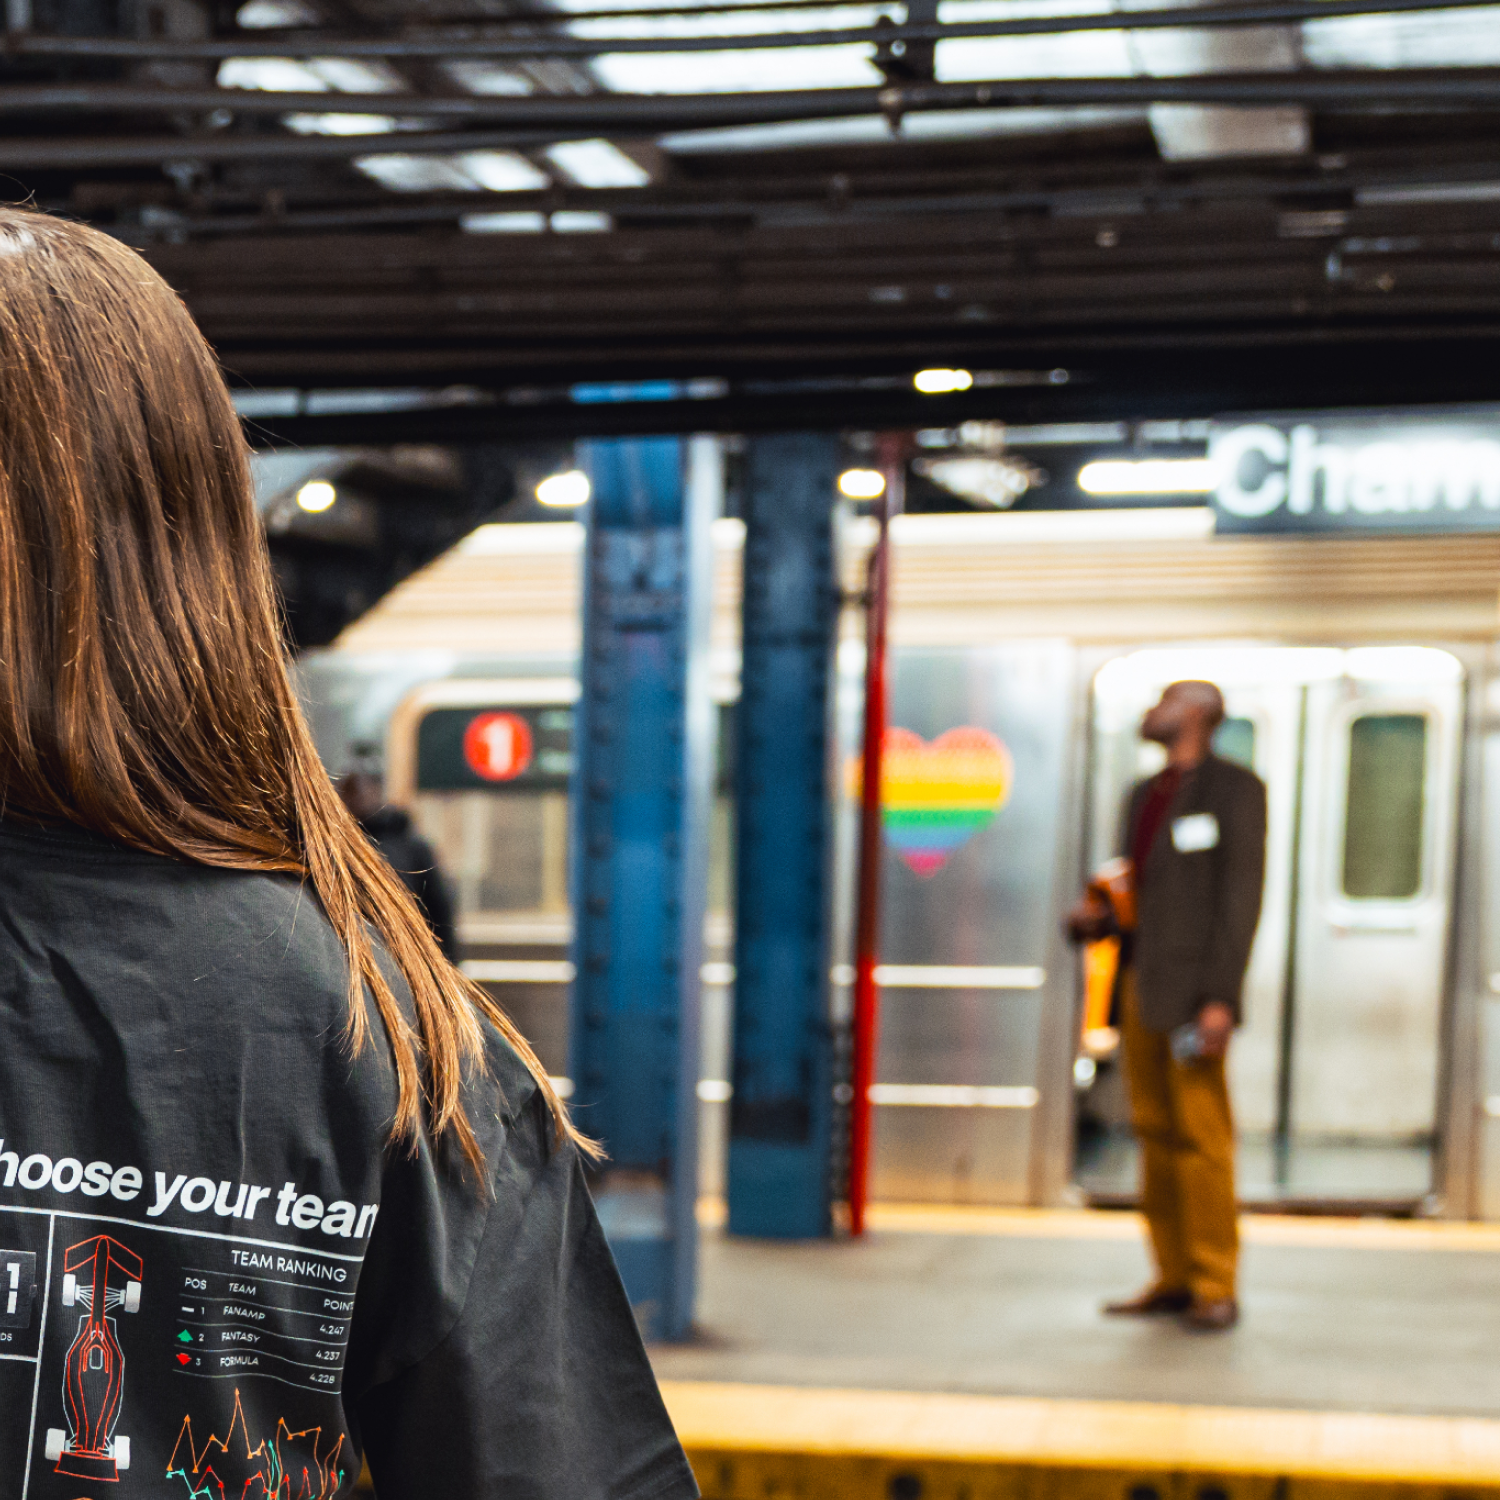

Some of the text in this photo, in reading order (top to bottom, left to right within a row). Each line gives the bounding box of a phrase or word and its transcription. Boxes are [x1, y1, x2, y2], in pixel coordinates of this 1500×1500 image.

[488, 721, 511, 770] 1
[146, 1171, 271, 1220] your
[231, 1250, 347, 1282] TEAM RANKING
[184, 1277, 207, 1290] POS
[228, 1283, 256, 1295] TEAM
[223, 1306, 265, 1320] FANAMP
[221, 1331, 260, 1343] FANTASY
[220, 1356, 259, 1368] FORMULA
